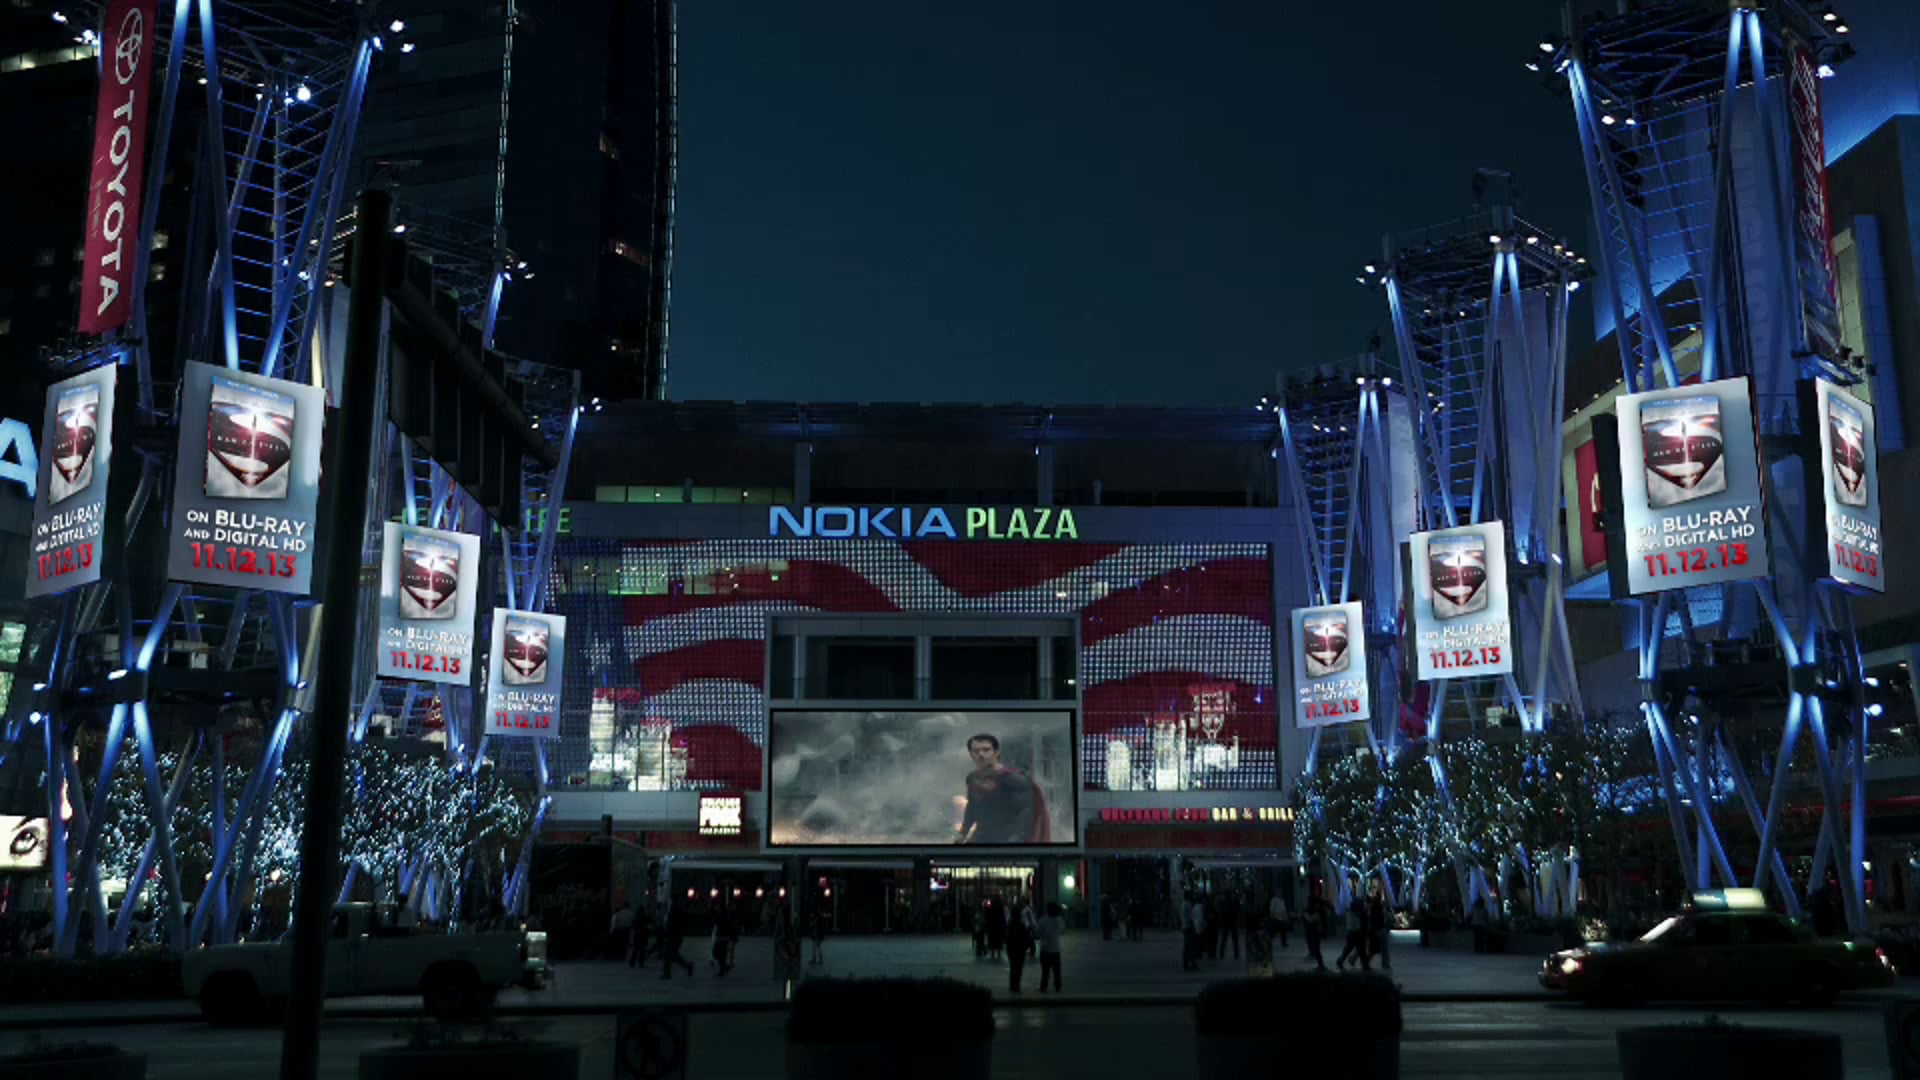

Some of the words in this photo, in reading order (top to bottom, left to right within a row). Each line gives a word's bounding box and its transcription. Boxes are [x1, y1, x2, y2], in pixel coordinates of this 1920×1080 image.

[97, 89, 135, 316] TOYOTA
[187, 509, 209, 524] ON
[215, 509, 306, 537] BLU-RAY
[769, 505, 957, 538] NOKIA
[966, 507, 1078, 539] PLAZA
[1663, 505, 1751, 533] BLU-RAY
[184, 528, 210, 540] AND
[214, 528, 279, 549] DIGITAL
[283, 538, 307, 552] HD
[1664, 528, 1728, 548] DIGITAL
[1731, 523, 1755, 539] HD
[191, 543, 297, 578] 11.12.13
[1644, 543, 1749, 577] 11.12.13
[407, 627, 467, 645] BLU-RAY
[391, 651, 462, 675] 11.12.13
[1430, 646, 1501, 669] 11.12.13
[495, 711, 552, 729] 11.12.13
[1304, 699, 1361, 720] 11.12.13
